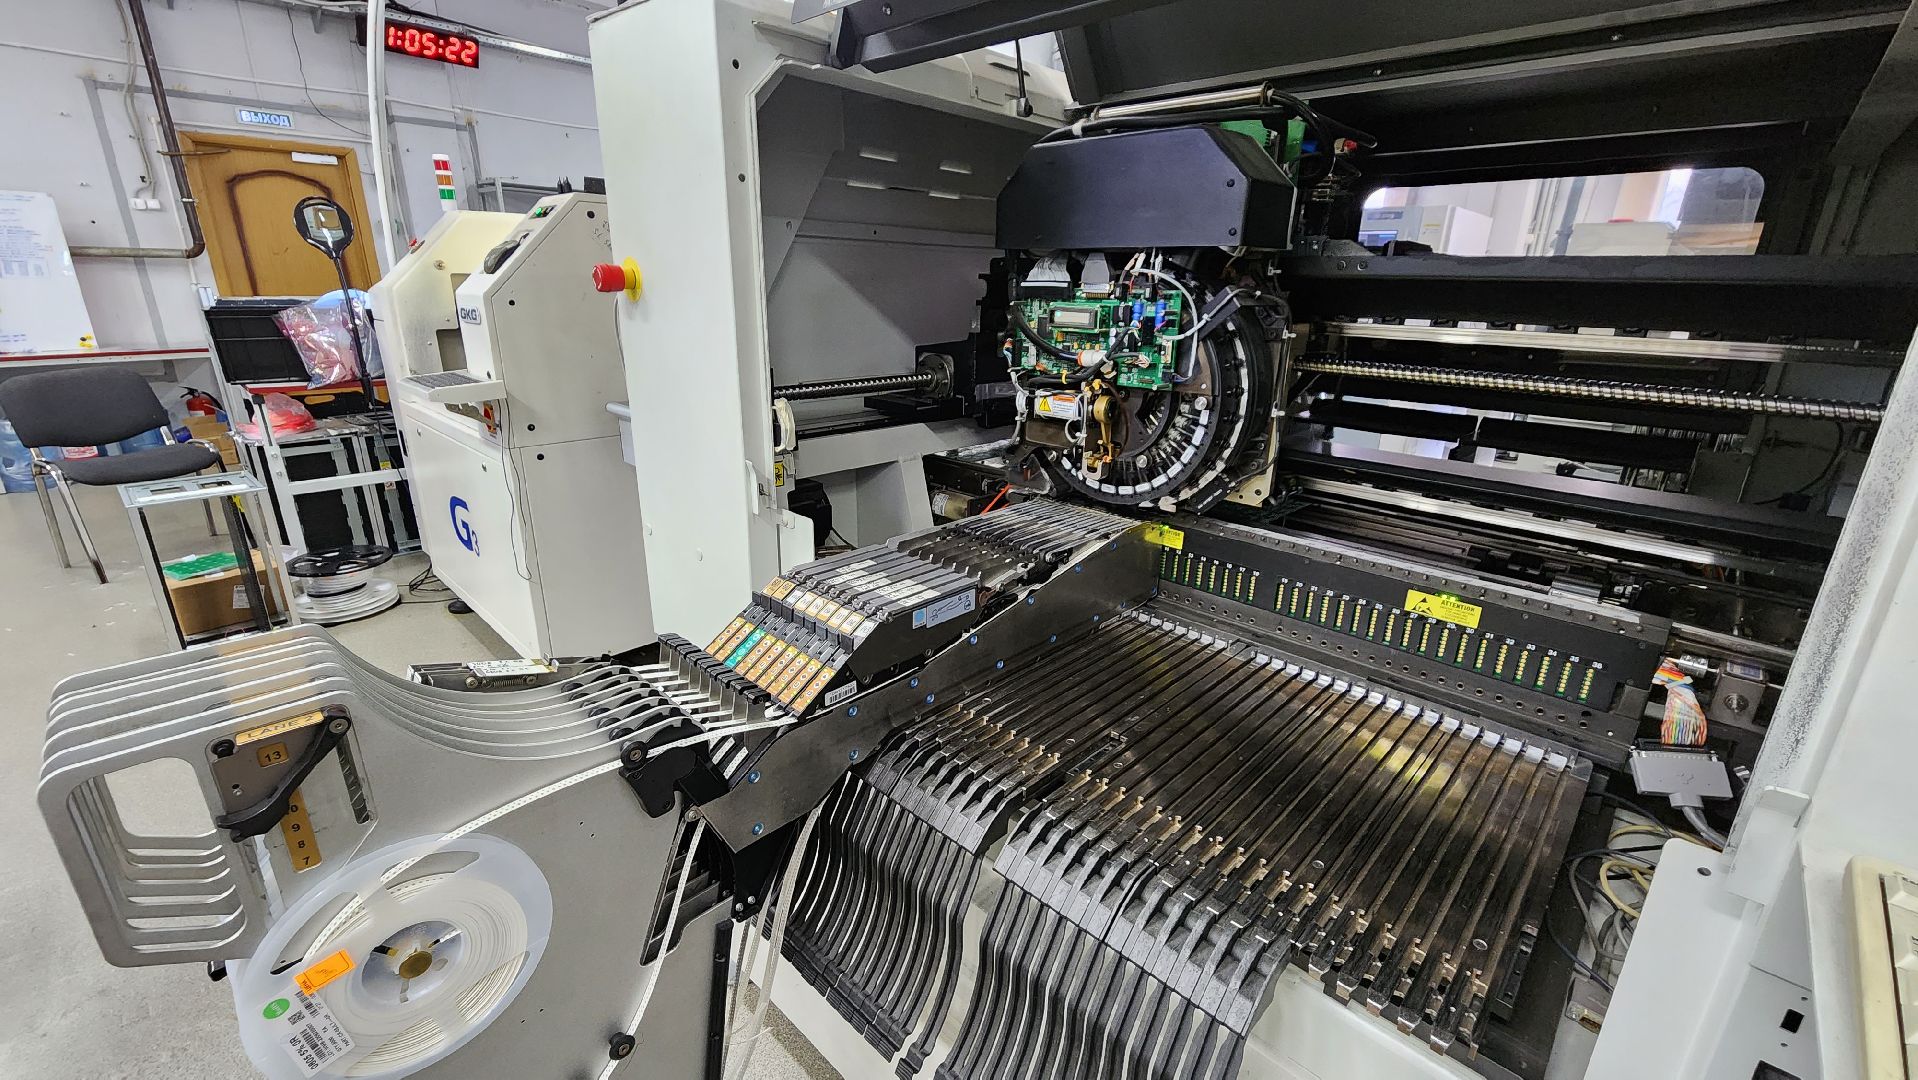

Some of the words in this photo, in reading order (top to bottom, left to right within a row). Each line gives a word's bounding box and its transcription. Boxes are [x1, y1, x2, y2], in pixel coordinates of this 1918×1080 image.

[240, 110, 290, 127] ВЫХОД
[460, 307, 478, 321] GKG
[1440, 600, 1476, 612] ATTENTION
[247, 720, 298, 738] LANE
[264, 750, 282, 762] 13
[292, 823, 300, 832] 9
[298, 840, 306, 849] 8
[302, 856, 310, 866] 7
[296, 1044, 308, 1056] 5%
[304, 1054, 318, 1070] 0805
